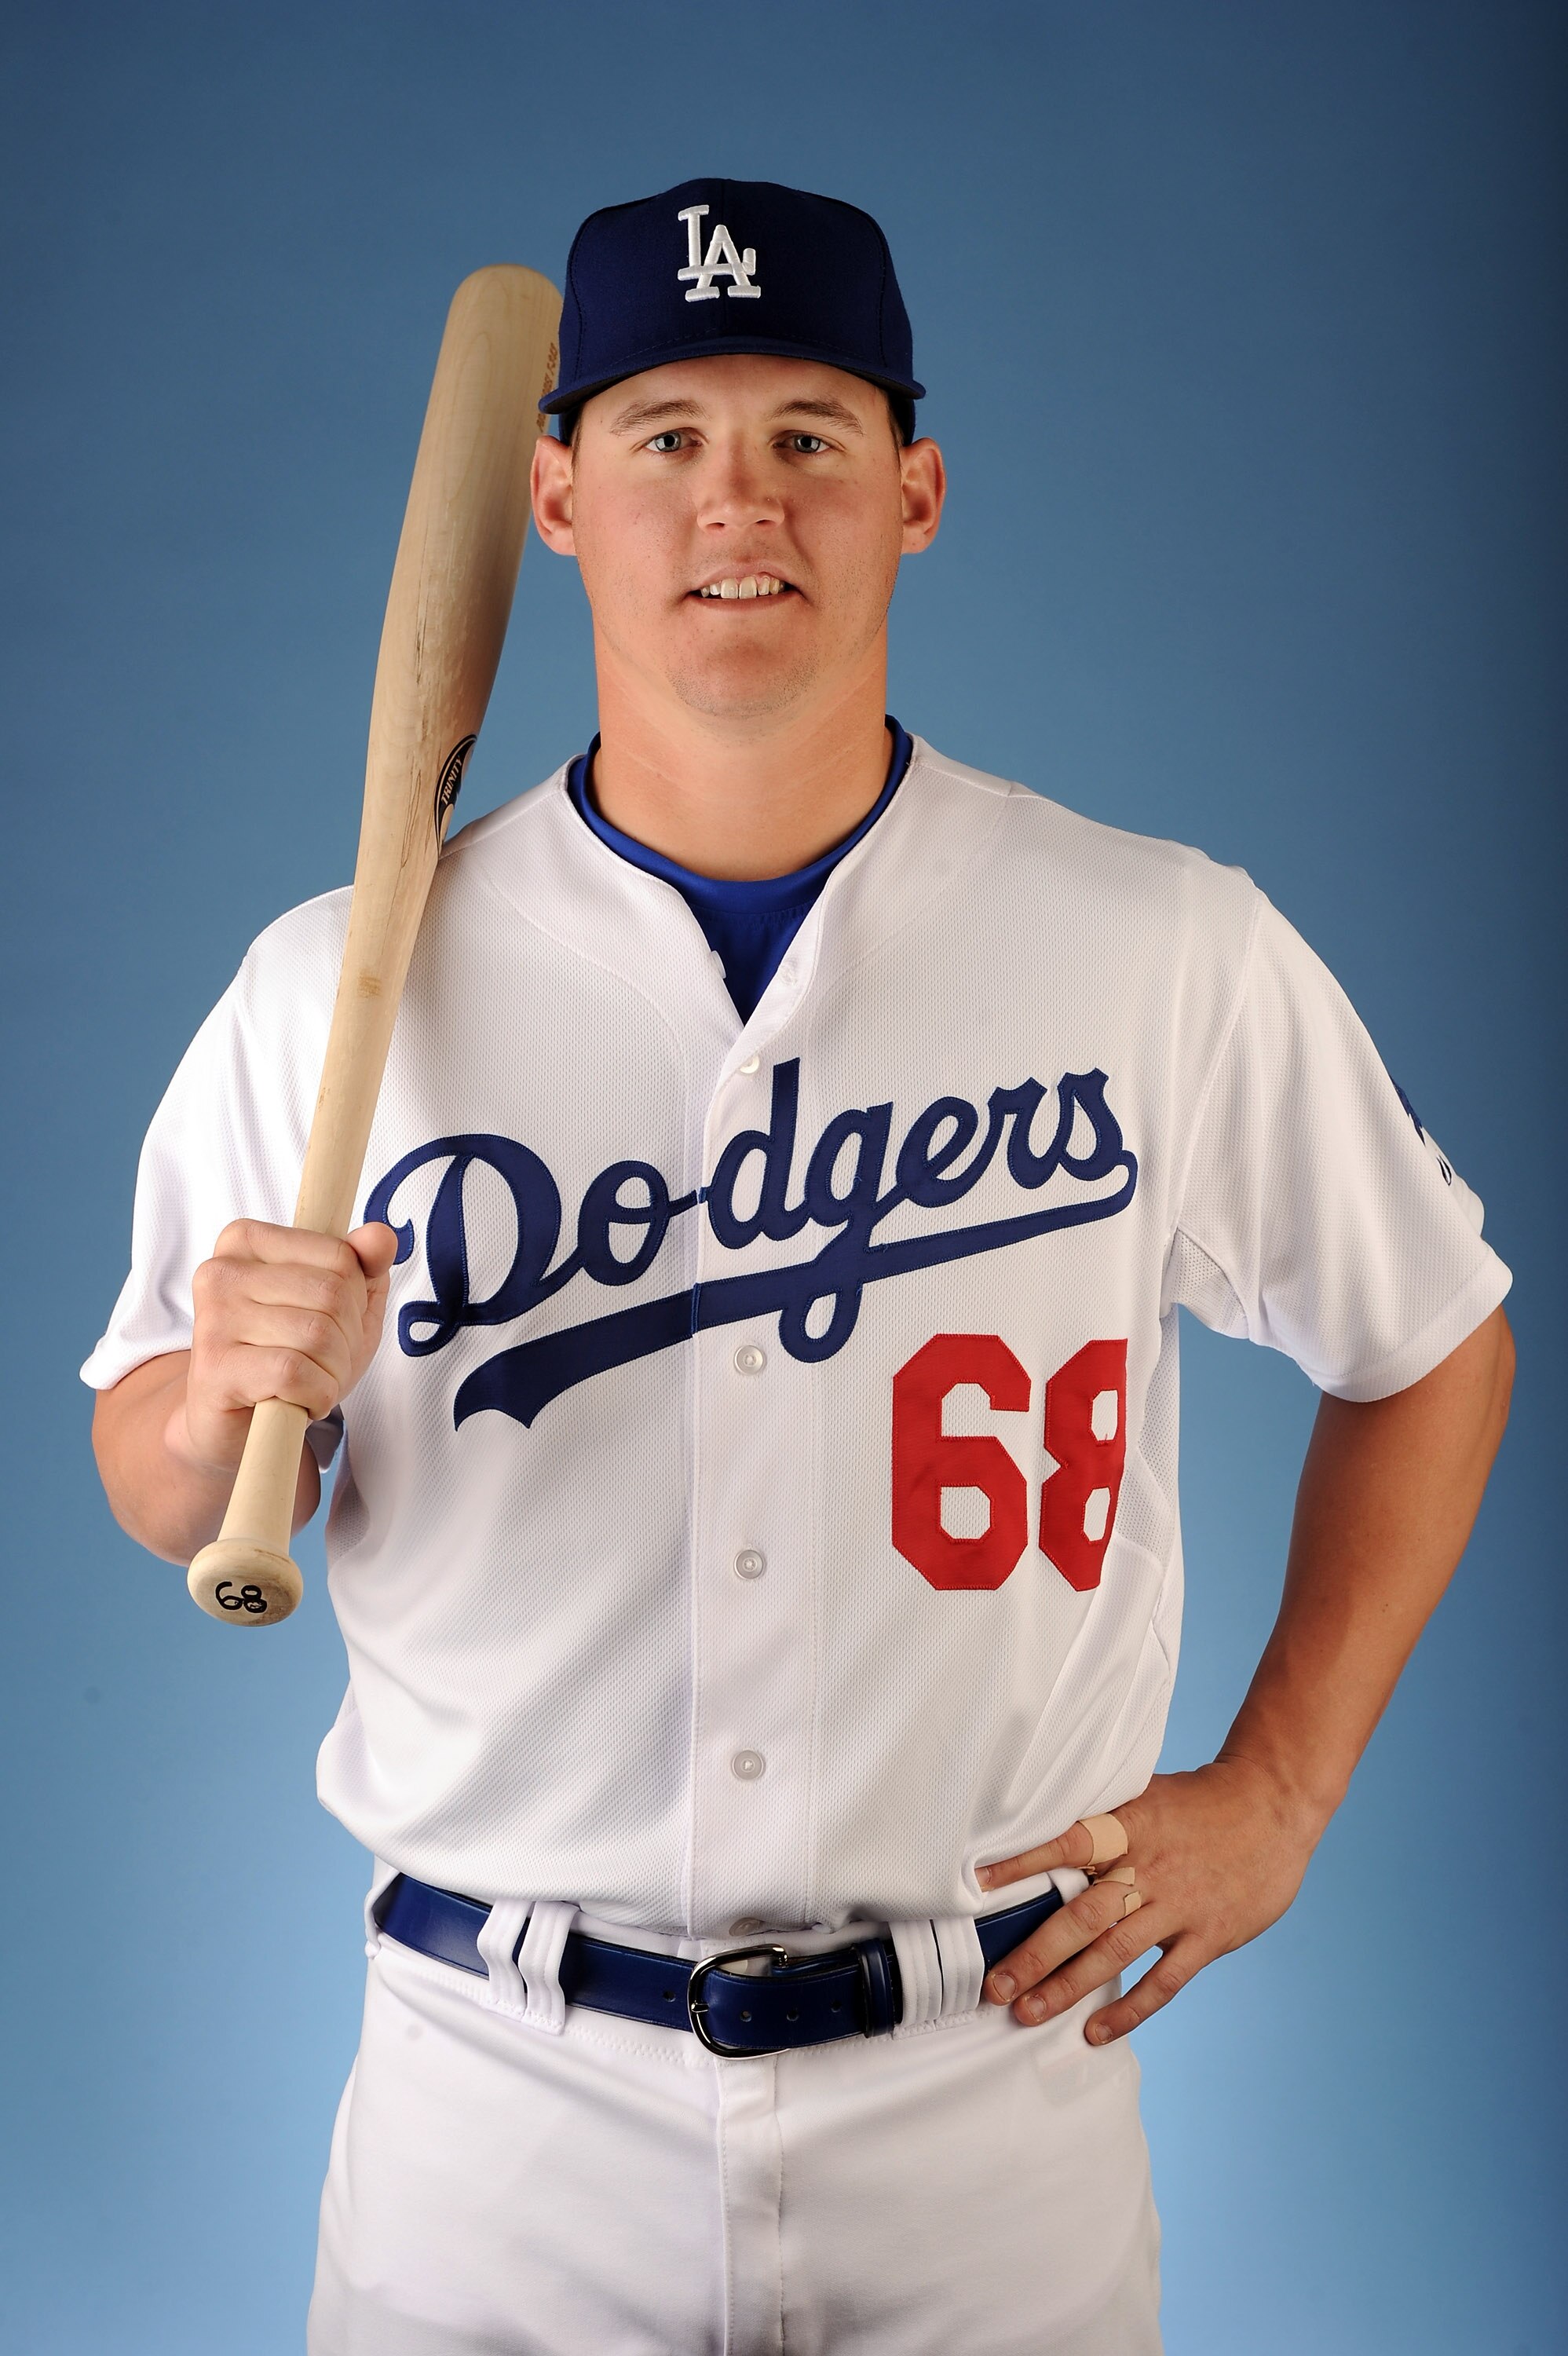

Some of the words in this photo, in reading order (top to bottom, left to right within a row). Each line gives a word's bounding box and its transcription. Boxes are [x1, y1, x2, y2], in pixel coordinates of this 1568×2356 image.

[678, 204, 761, 302] LA
[440, 755, 463, 806] TRINITY
[364, 1057, 1138, 1363] Dodgers
[892, 1333, 1128, 1591] 68
[215, 1581, 268, 1614] 68
